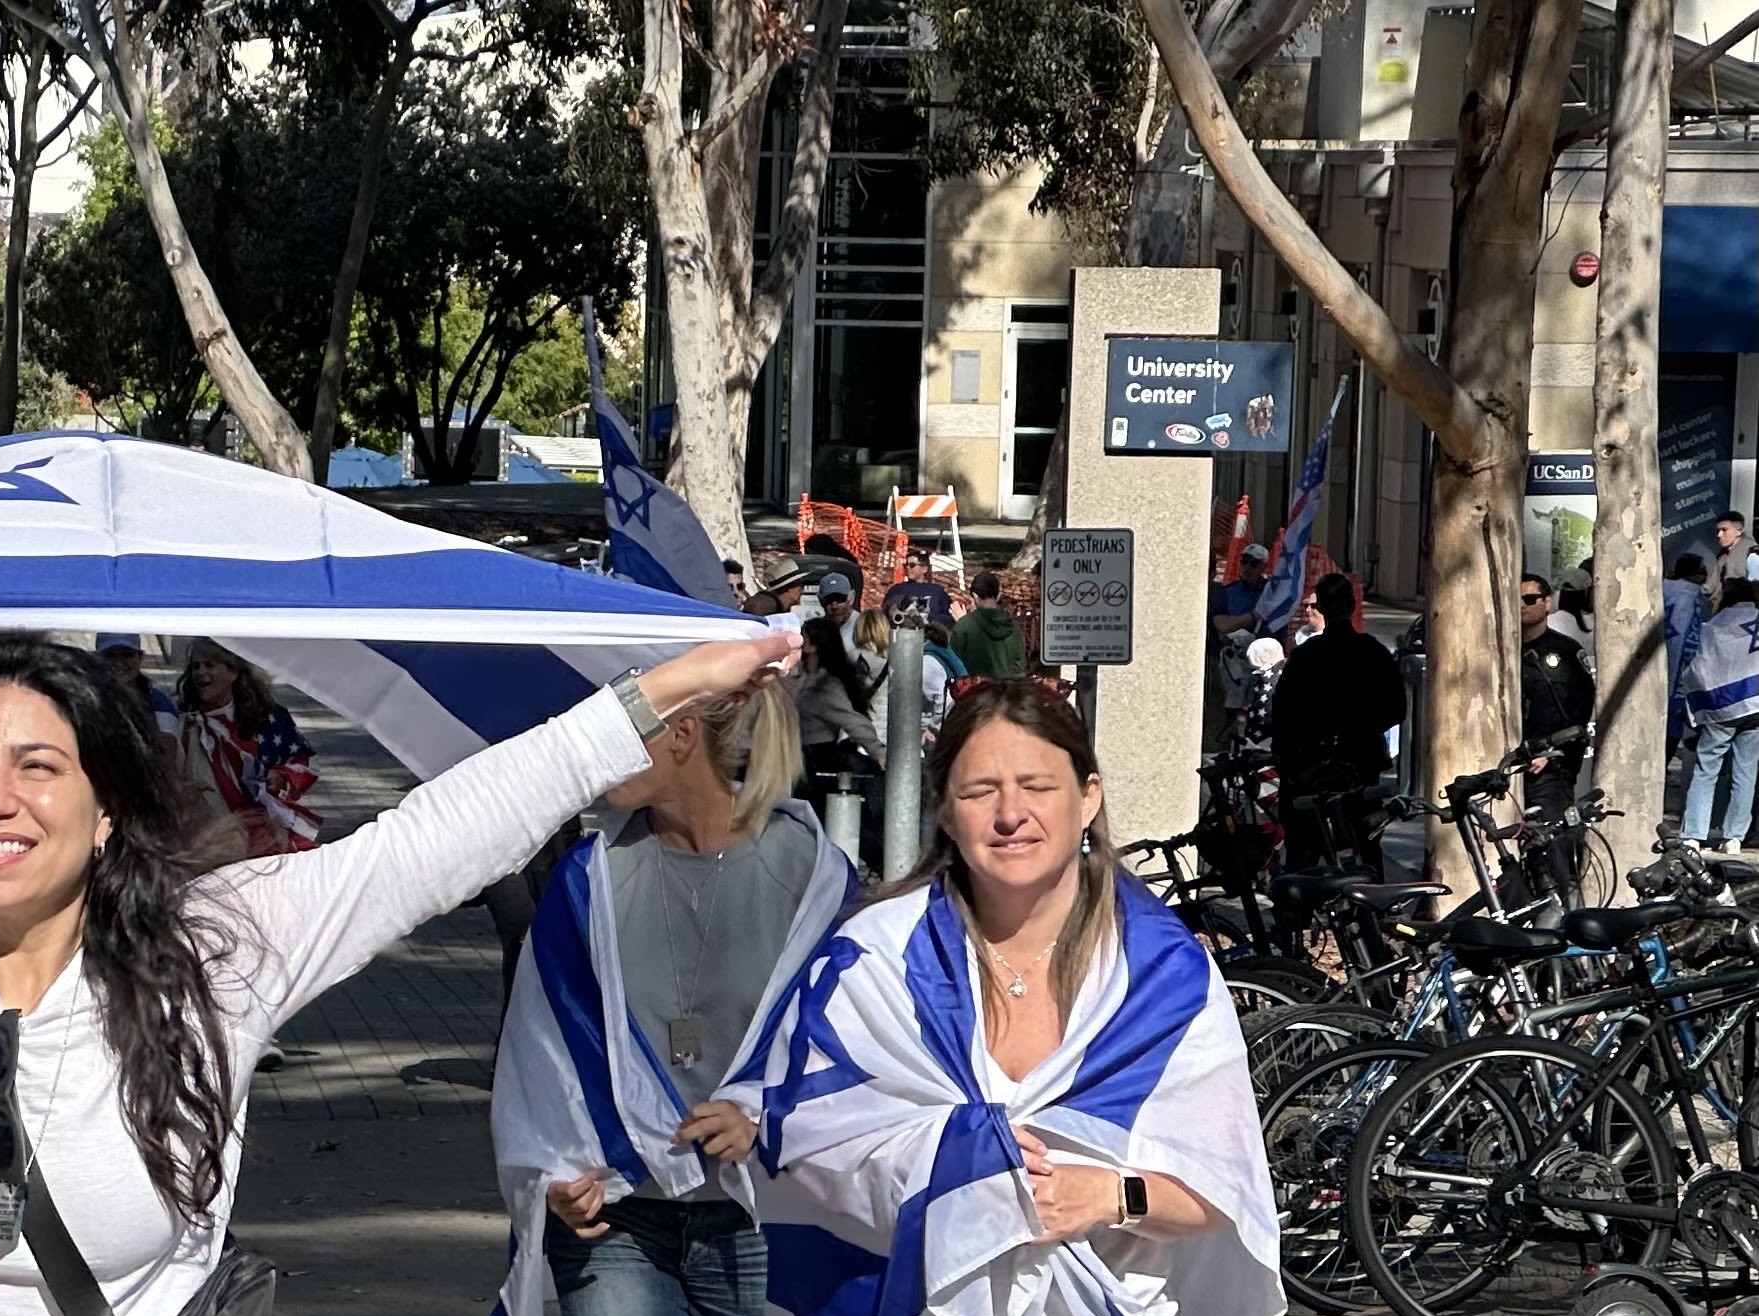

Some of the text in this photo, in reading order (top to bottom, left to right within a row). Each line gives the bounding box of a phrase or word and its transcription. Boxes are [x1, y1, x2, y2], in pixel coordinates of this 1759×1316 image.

[1127, 355, 1235, 384] University
[1125, 382, 1197, 404] Center
[1659, 411, 1713, 441] rcel center
[1671, 447, 1717, 473] shipping
[1533, 464, 1594, 480] UC San D
[1676, 469, 1716, 491] mailing
[1674, 488, 1715, 511] stamps
[1684, 509, 1717, 530] rental
[1050, 538, 1126, 554] PEDESTRIANS
[1073, 559, 1102, 574] ONLY
